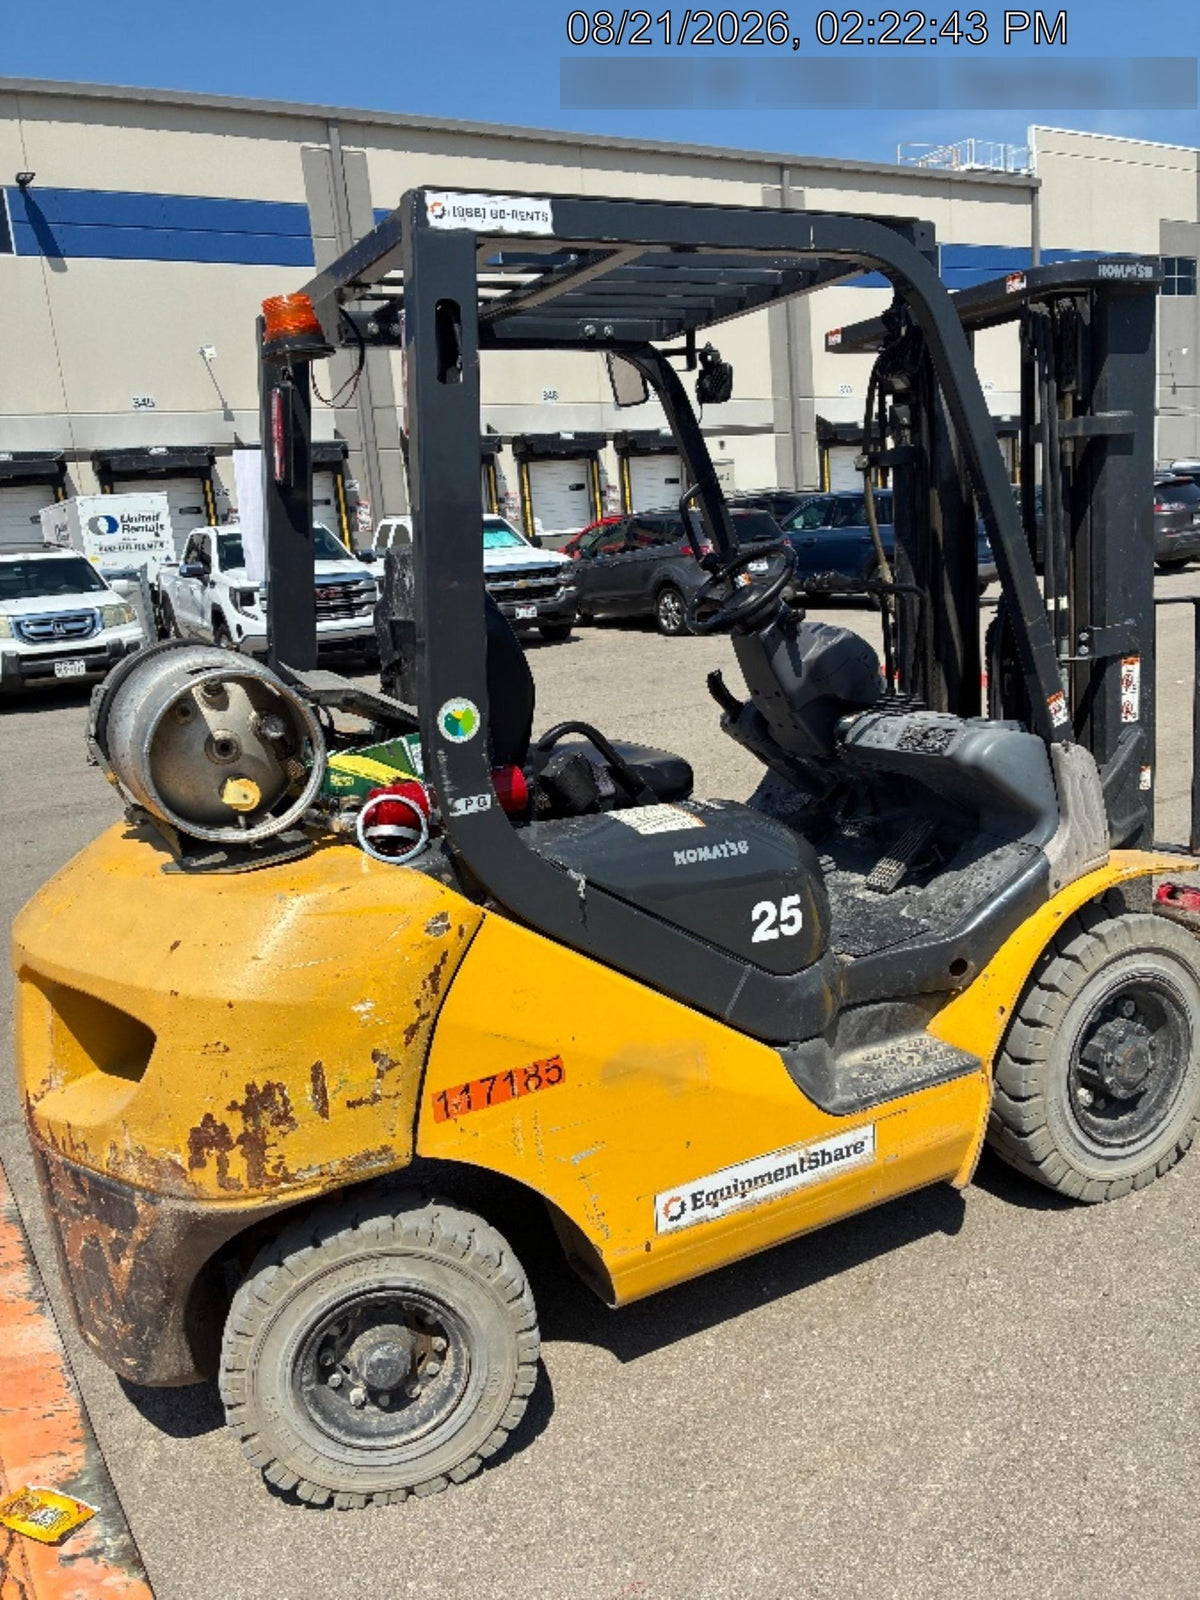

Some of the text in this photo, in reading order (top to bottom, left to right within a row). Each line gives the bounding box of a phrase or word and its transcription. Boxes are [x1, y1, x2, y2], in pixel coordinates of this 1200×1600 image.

[120, 511, 161, 523] United
[122, 522, 165, 534] Rentals
[673, 840, 750, 866] KOMATSU
[751, 893, 803, 943] 25
[436, 1054, 564, 1119] 117185
[690, 1139, 867, 1212] EquipmentShare
